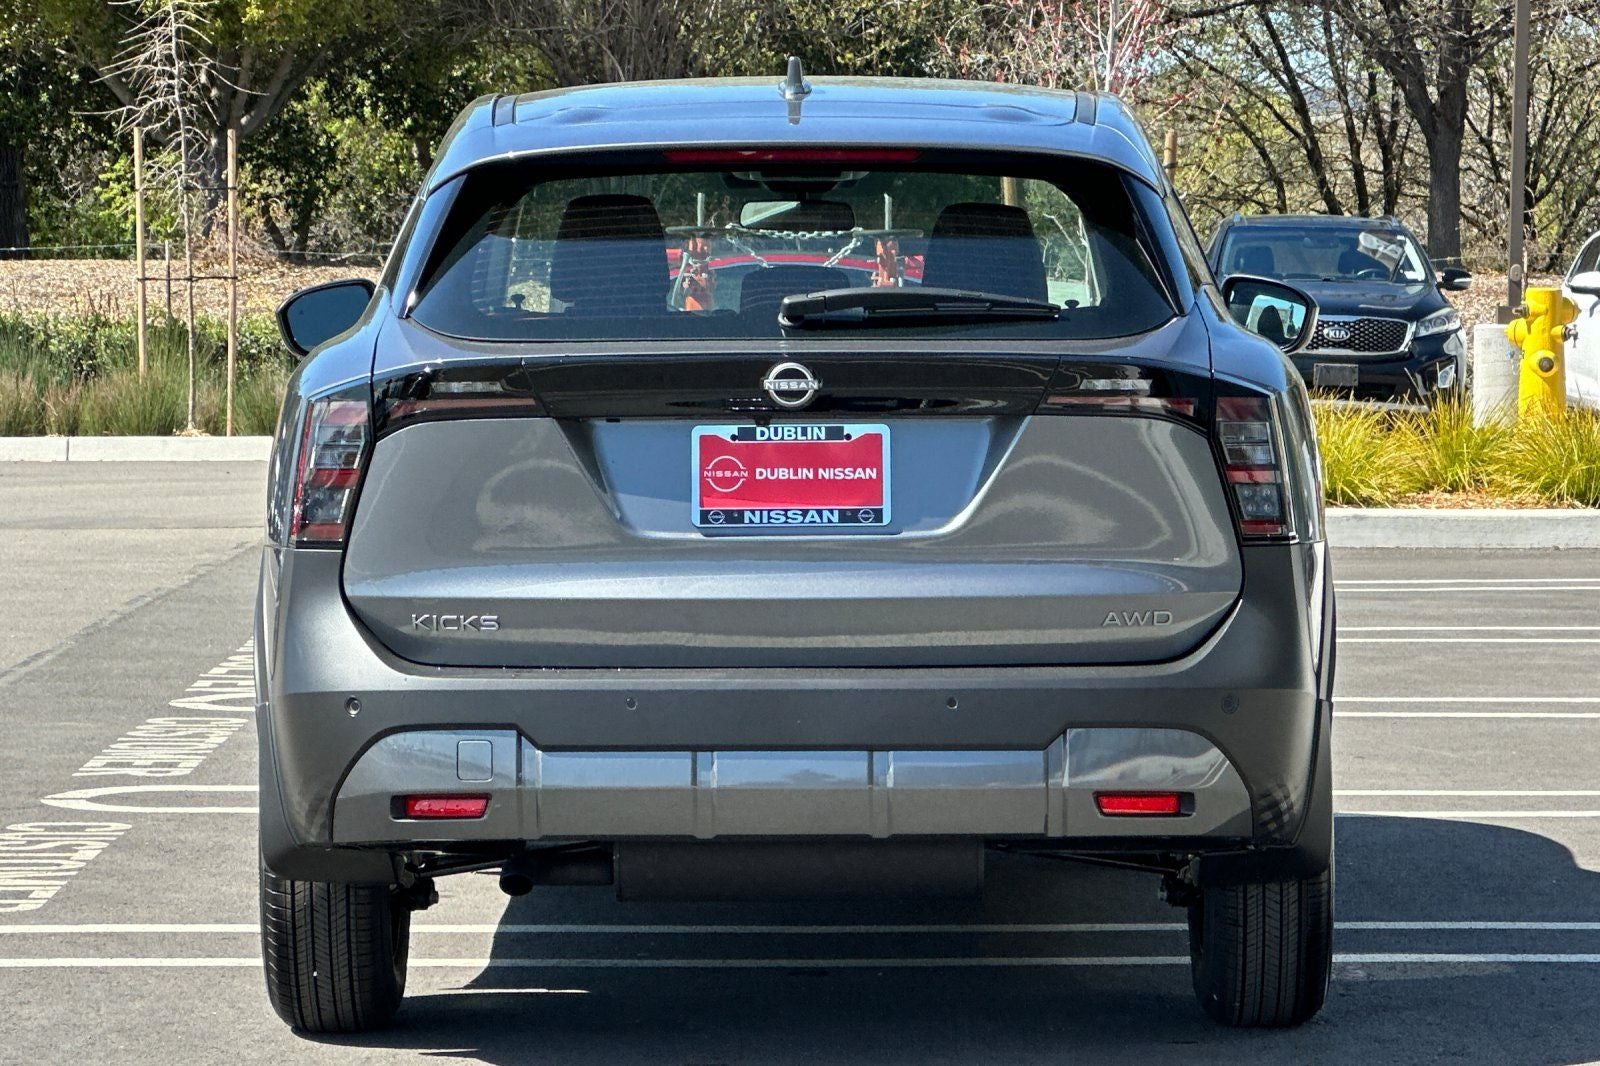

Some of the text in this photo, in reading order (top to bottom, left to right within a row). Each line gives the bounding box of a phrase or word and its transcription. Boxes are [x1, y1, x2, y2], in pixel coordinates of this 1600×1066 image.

[1328, 329, 1347, 339] KIA
[764, 380, 818, 390] NISSAN
[755, 426, 826, 441] DUBLIN
[703, 470, 748, 478] NISSAN
[755, 467, 877, 480] DUBLIN NISSAN
[743, 509, 839, 524] NISSAN
[411, 613, 500, 631] KICKS
[1102, 611, 1173, 627] AWD
[72, 717, 249, 777] CUSTOMER
